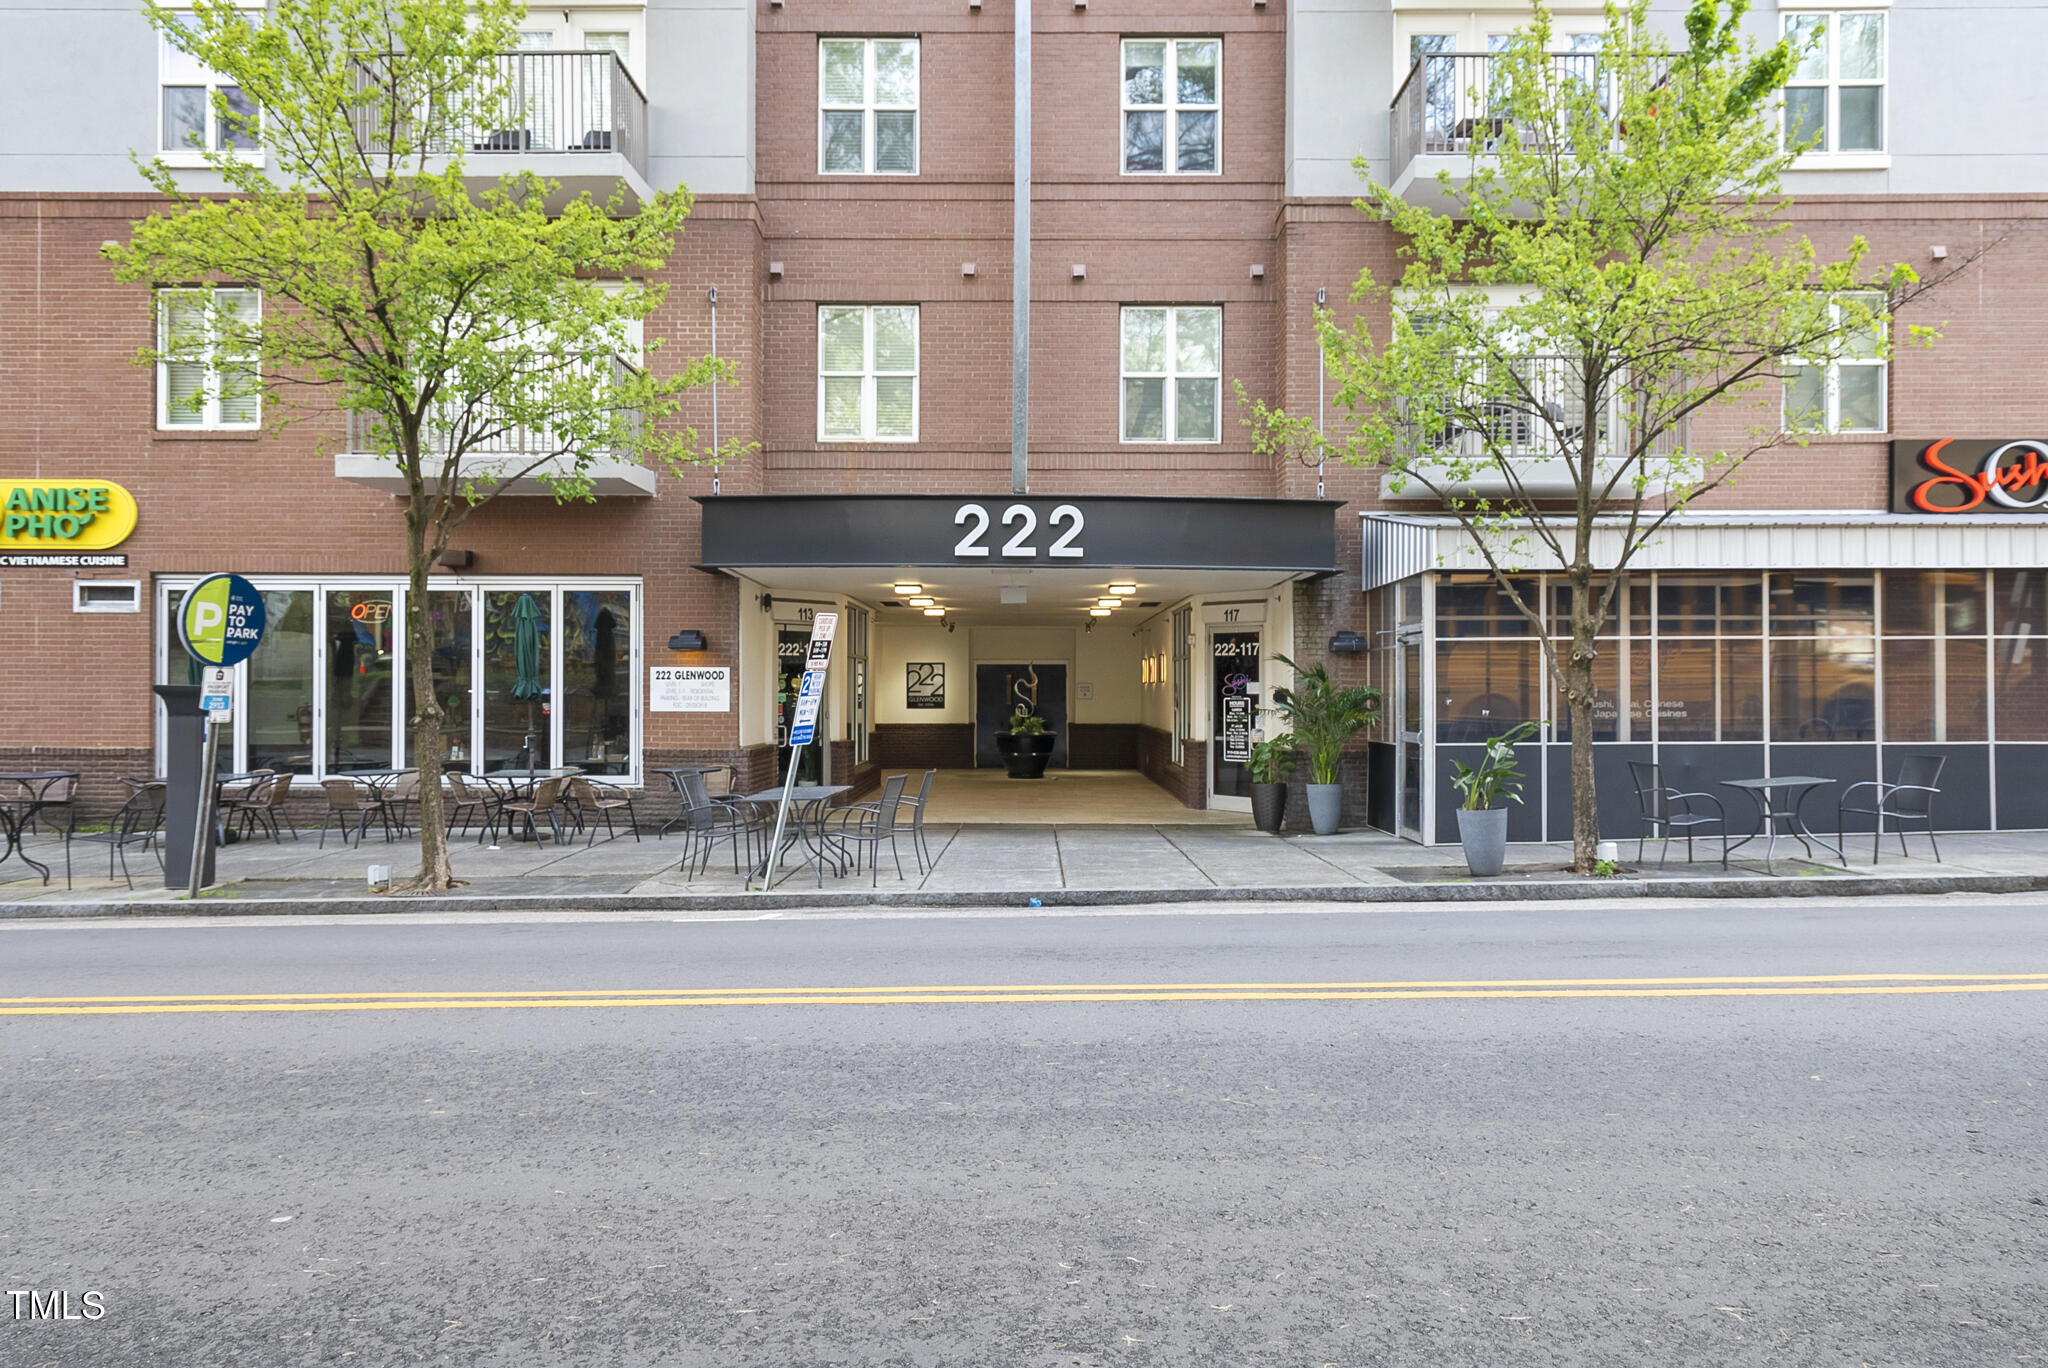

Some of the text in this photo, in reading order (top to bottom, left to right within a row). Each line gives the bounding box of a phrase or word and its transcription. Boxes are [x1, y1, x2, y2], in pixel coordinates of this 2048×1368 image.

[1914, 438, 2048, 512] Sush
[5, 488, 109, 511] ANISE
[954, 504, 1084, 557] 222
[8, 556, 79, 566] VIETNAMESE
[79, 556, 125, 566] CUISINE
[229, 604, 254, 616] PAY
[798, 608, 814, 620] 113
[1224, 609, 1240, 622] 117
[193, 601, 223, 636] P
[228, 616, 246, 627] TO
[226, 627, 258, 639] PARK
[778, 642, 809, 656] 222-1
[1214, 643, 1259, 656] 222-117
[656, 671, 725, 680] 222 GLENWOOD
[907, 664, 944, 695] 222
[802, 676, 811, 693] 2
[1591, 700, 1614, 708] ushi,
